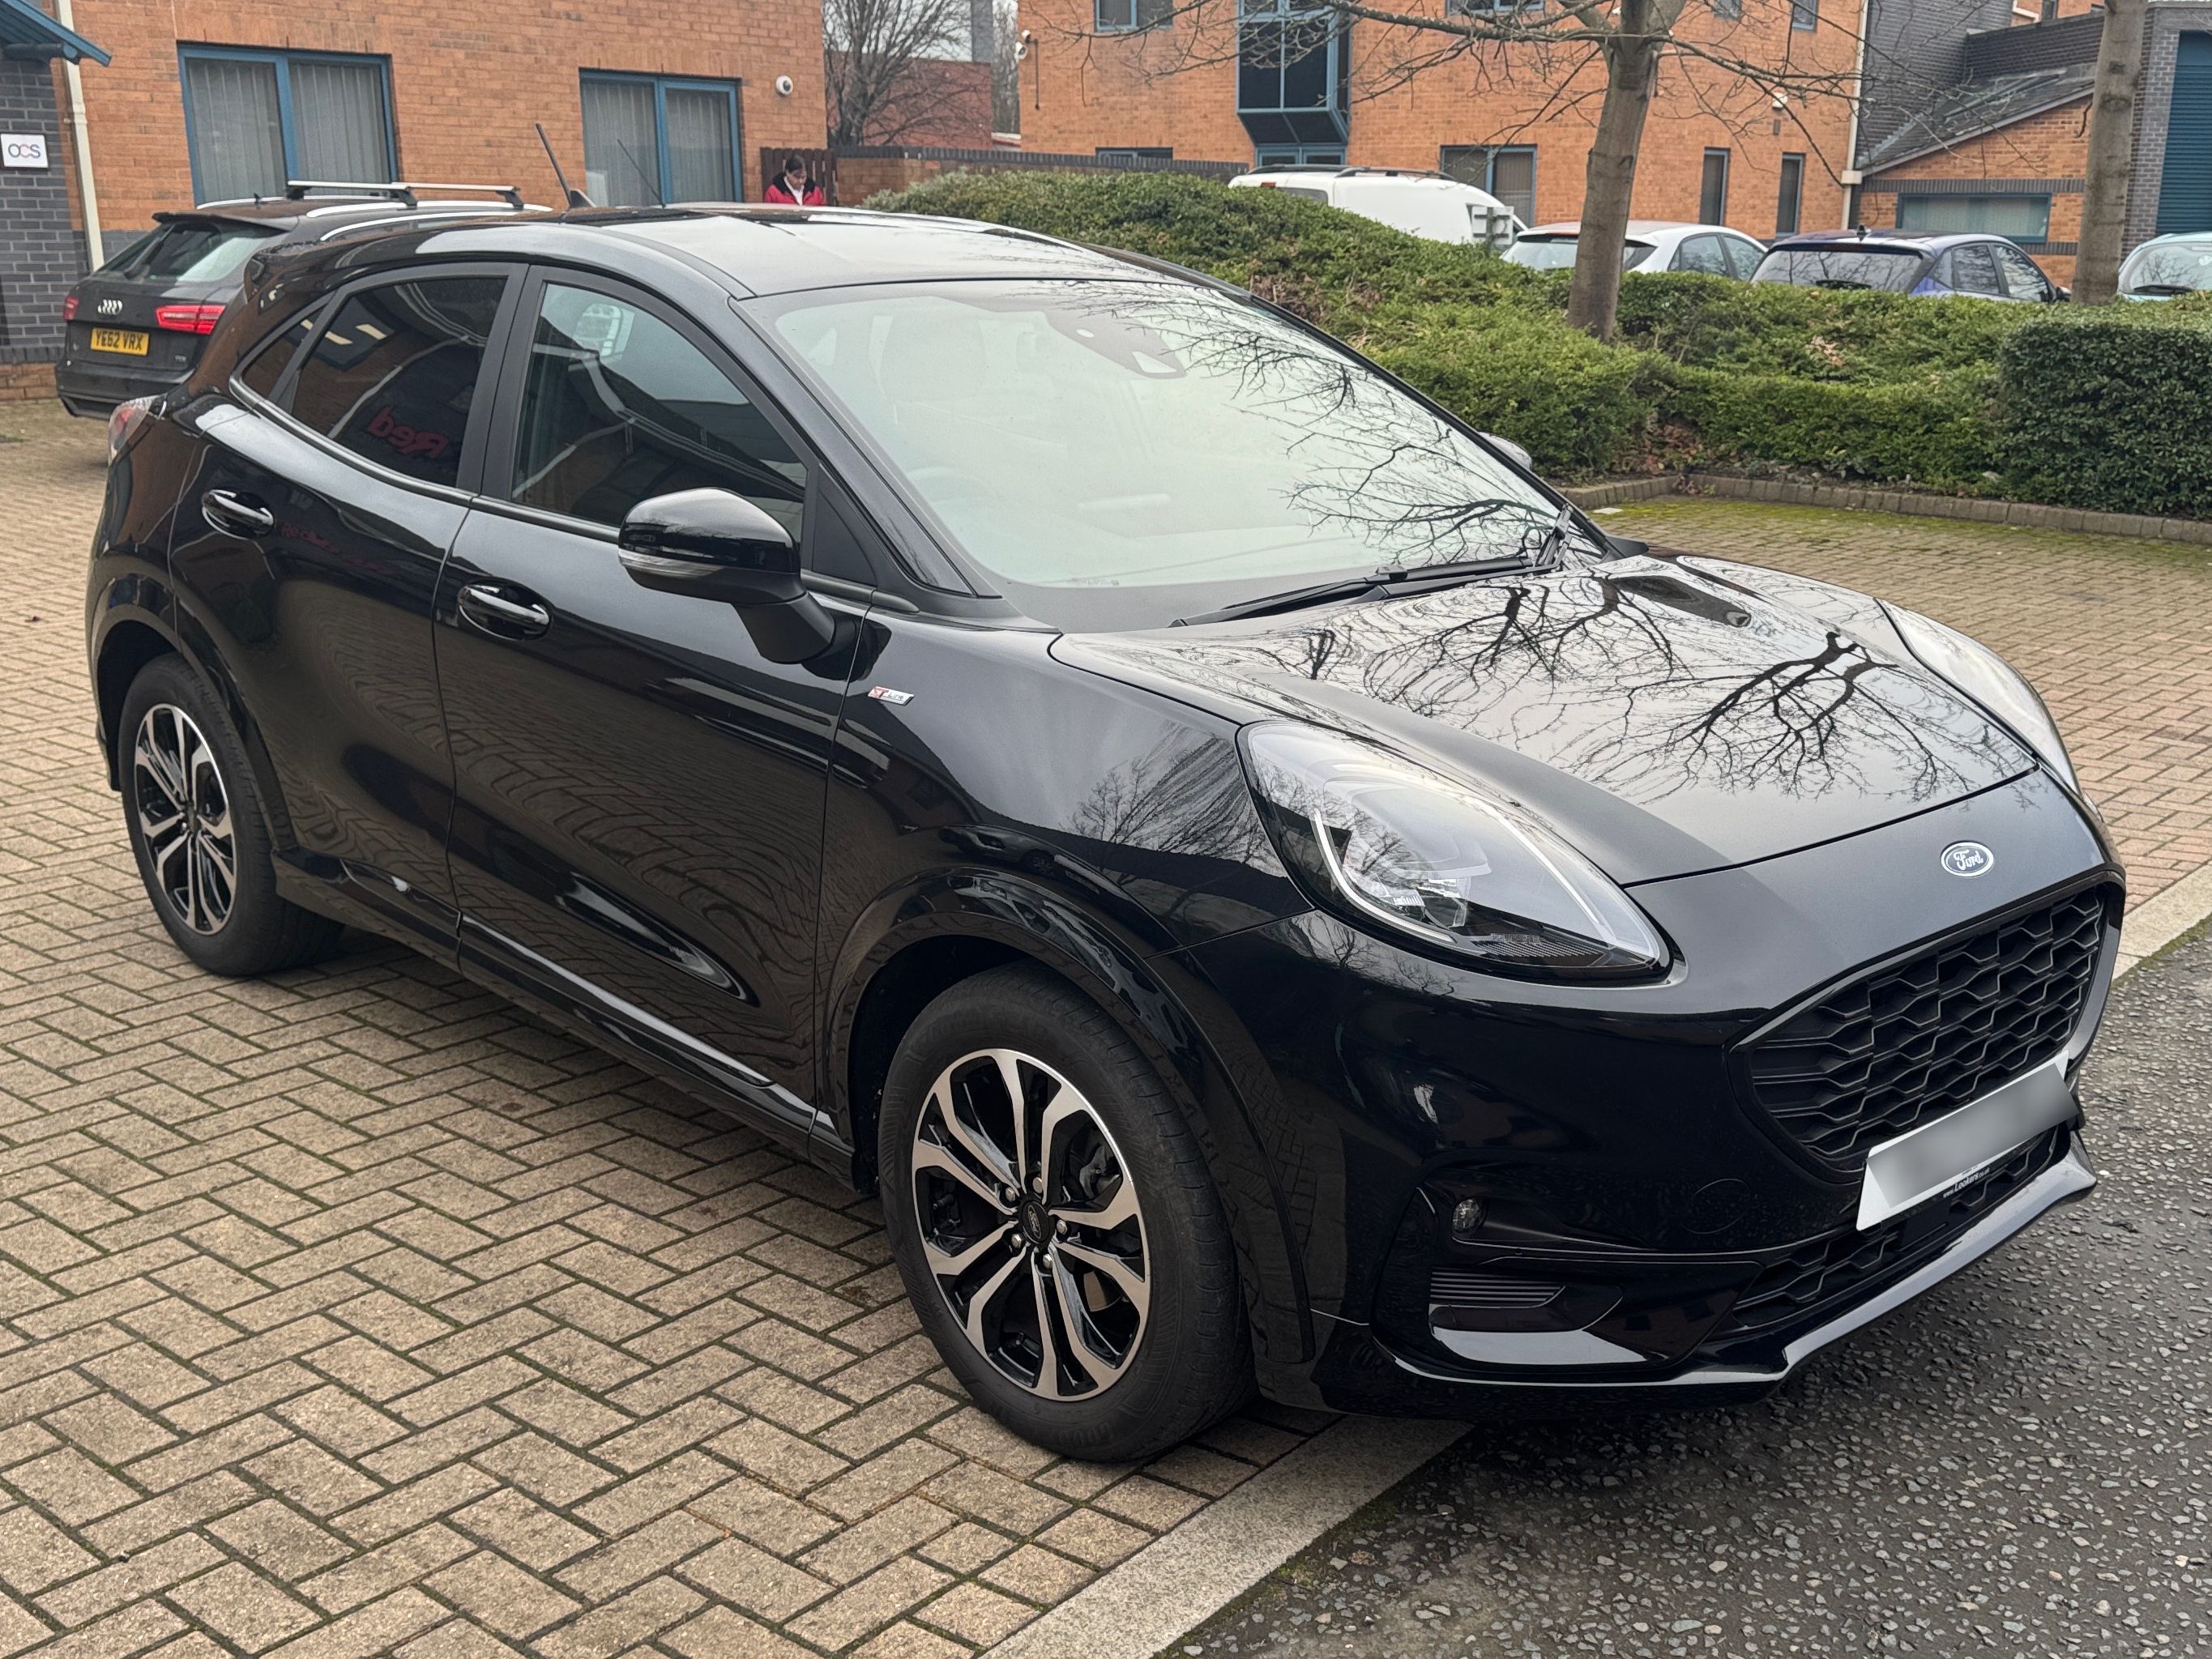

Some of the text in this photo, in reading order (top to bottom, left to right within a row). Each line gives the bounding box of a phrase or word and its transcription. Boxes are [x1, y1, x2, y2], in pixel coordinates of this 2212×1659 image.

[7, 143, 41, 159] OCS
[96, 330, 144, 351] YE62 VRX
[1953, 849, 1984, 871] Ford
